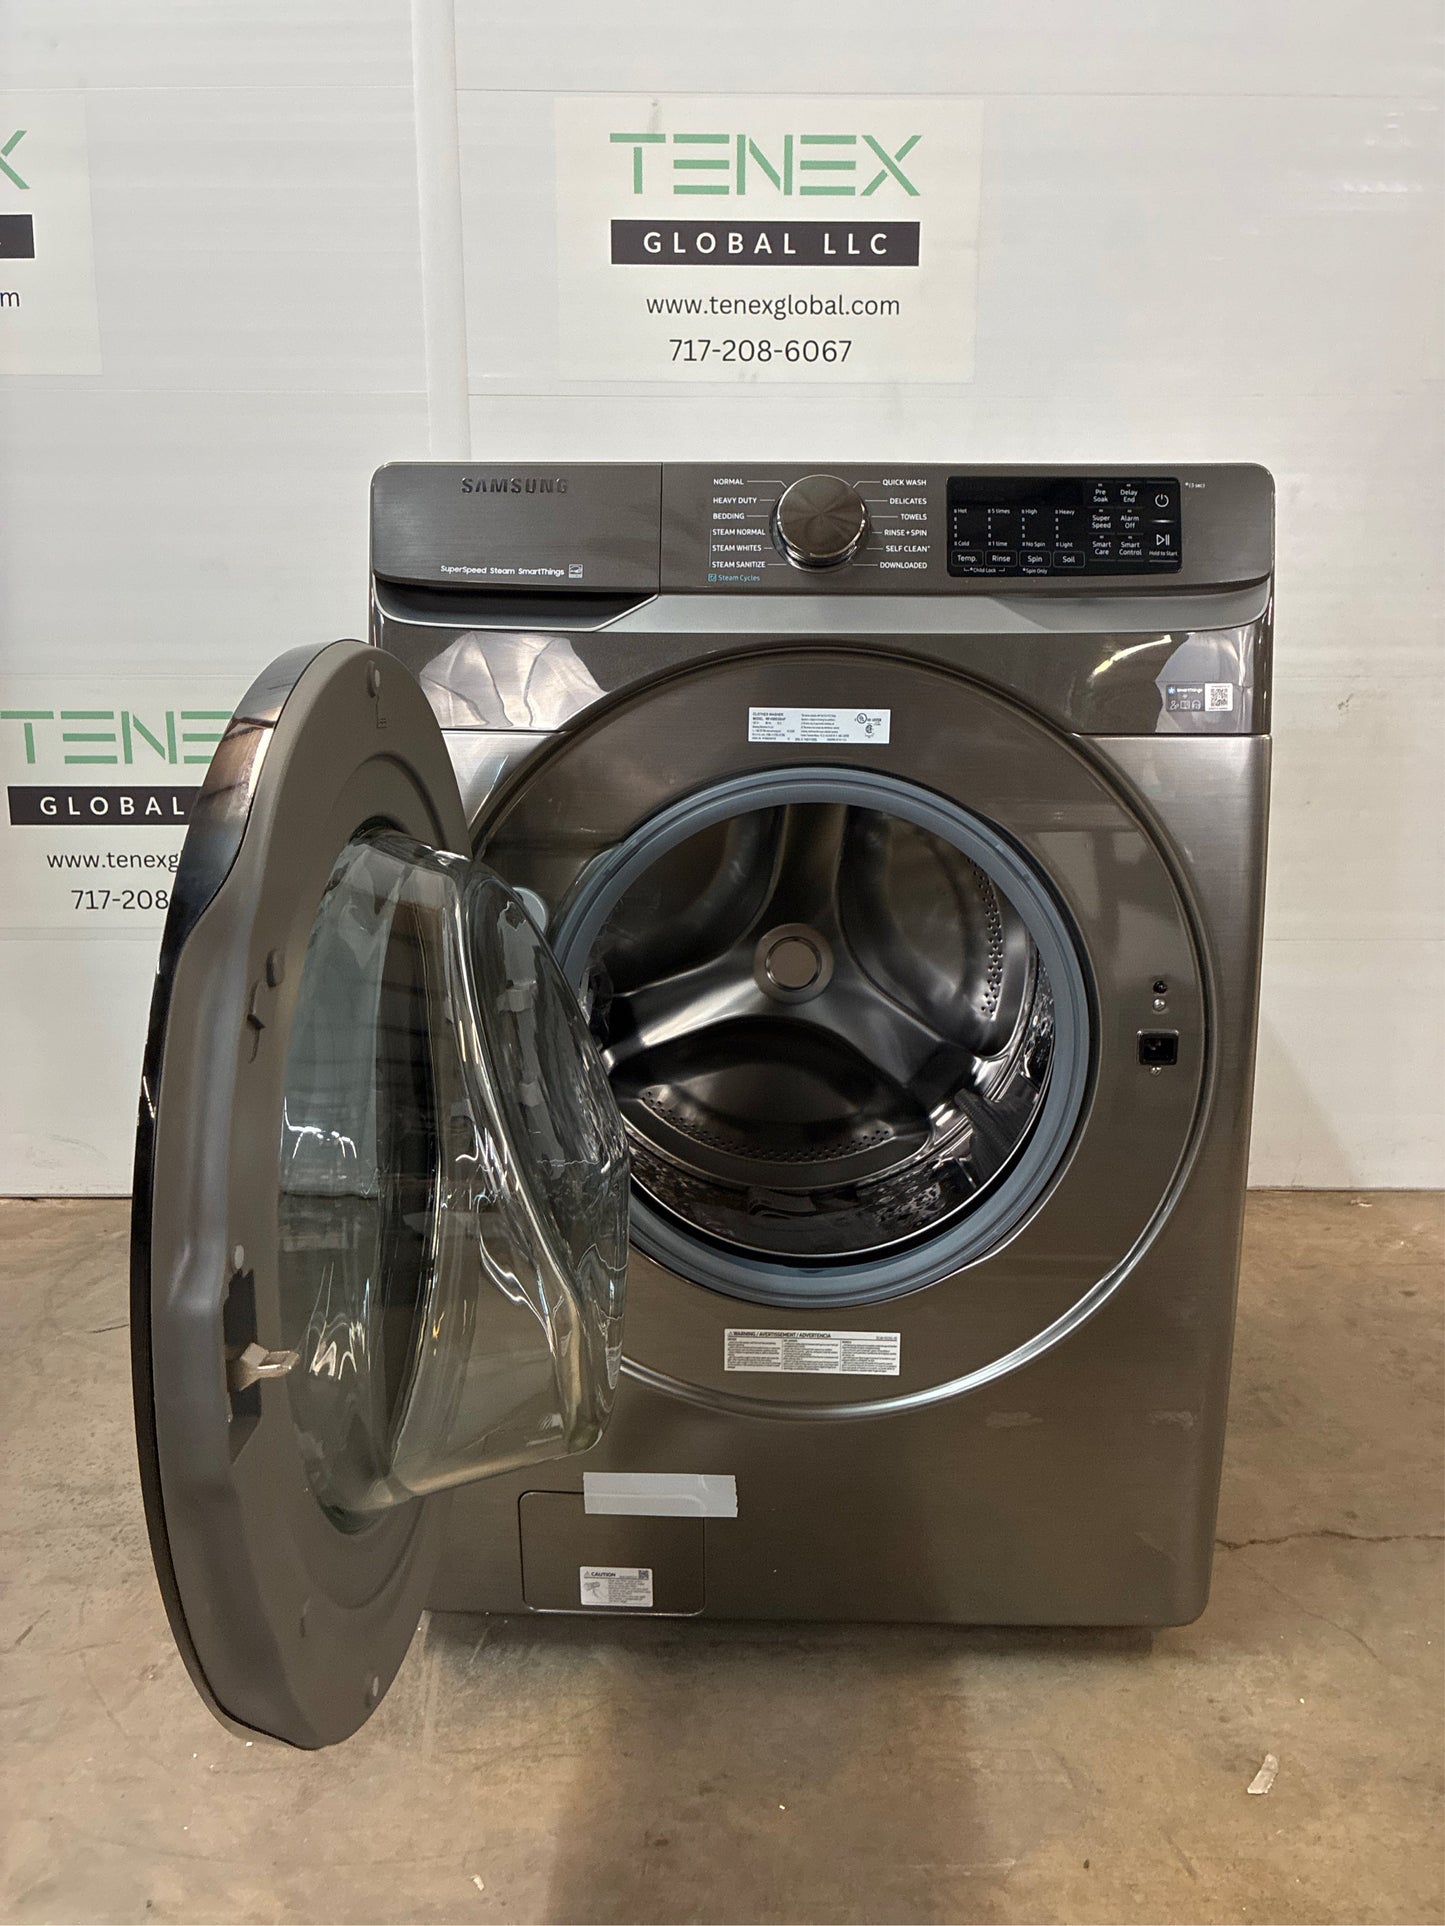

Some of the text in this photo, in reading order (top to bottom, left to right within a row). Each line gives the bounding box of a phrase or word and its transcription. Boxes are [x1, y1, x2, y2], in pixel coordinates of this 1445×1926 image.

[609, 133, 922, 196] TENEX
[643, 231, 888, 255] GLOBAL LLC
[646, 295, 900, 320] www.tenexglobal.com
[669, 338, 852, 362] 717-208-6067
[461, 478, 569, 494] SAMSUNG
[1120, 489, 1138, 497] Delay
[1092, 515, 1110, 523] Super
[1092, 522, 1111, 530] Speed
[1121, 541, 1140, 549] Smart
[1119, 548, 1142, 556] Control
[957, 555, 977, 563] Temp.
[1027, 556, 1043, 564] Spin
[441, 565, 564, 576] SuperSpeed Steam SmartThings
[740, 574, 760, 582] Cycles
[0, 711, 233, 764] TENE
[40, 796, 184, 815] GLOBAL
[47, 850, 182, 872] www.tenexg
[71, 890, 169, 910] 717-208
